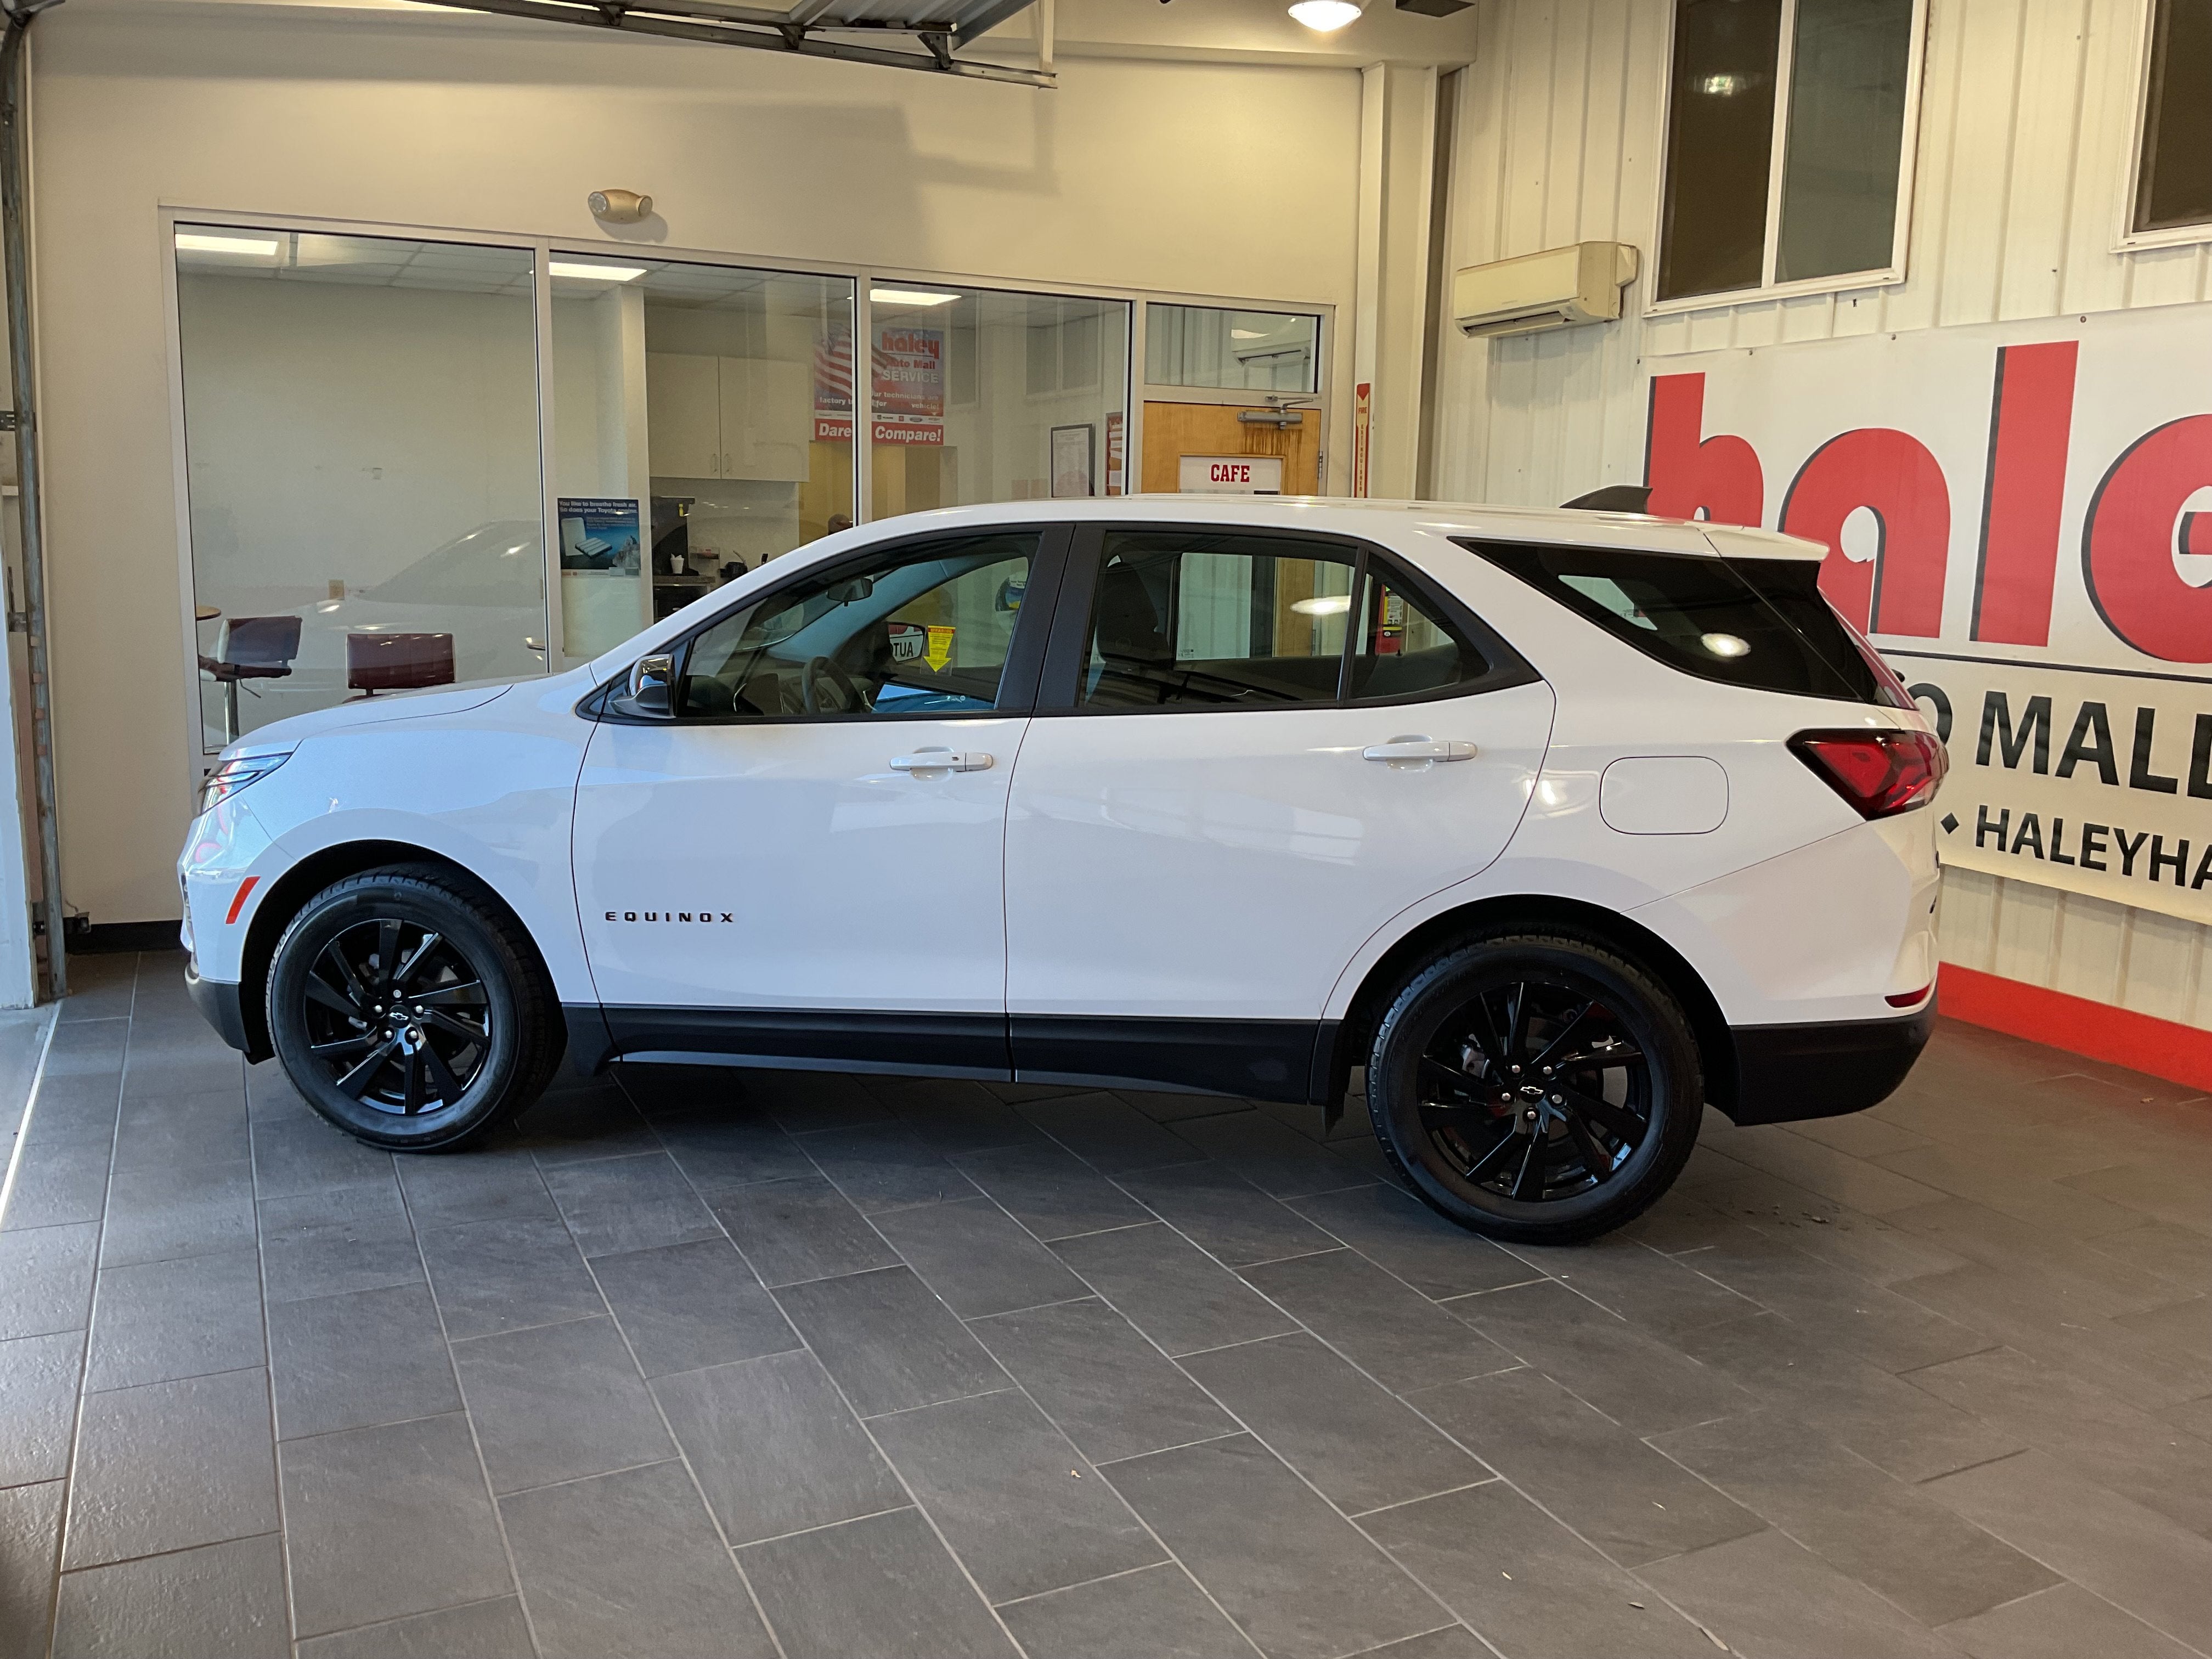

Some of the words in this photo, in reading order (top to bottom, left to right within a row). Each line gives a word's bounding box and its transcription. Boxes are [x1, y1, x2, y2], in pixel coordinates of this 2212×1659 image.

[882, 331, 940, 359] haley
[913, 360, 935, 369] Mall
[882, 369, 939, 383] SERVICE
[820, 396, 846, 405] factory
[884, 391, 926, 399] technicians
[819, 422, 852, 437] Dare
[875, 425, 941, 443] Compare!
[1210, 464, 1250, 482] CAFE
[605, 911, 733, 923] EQUINOX
